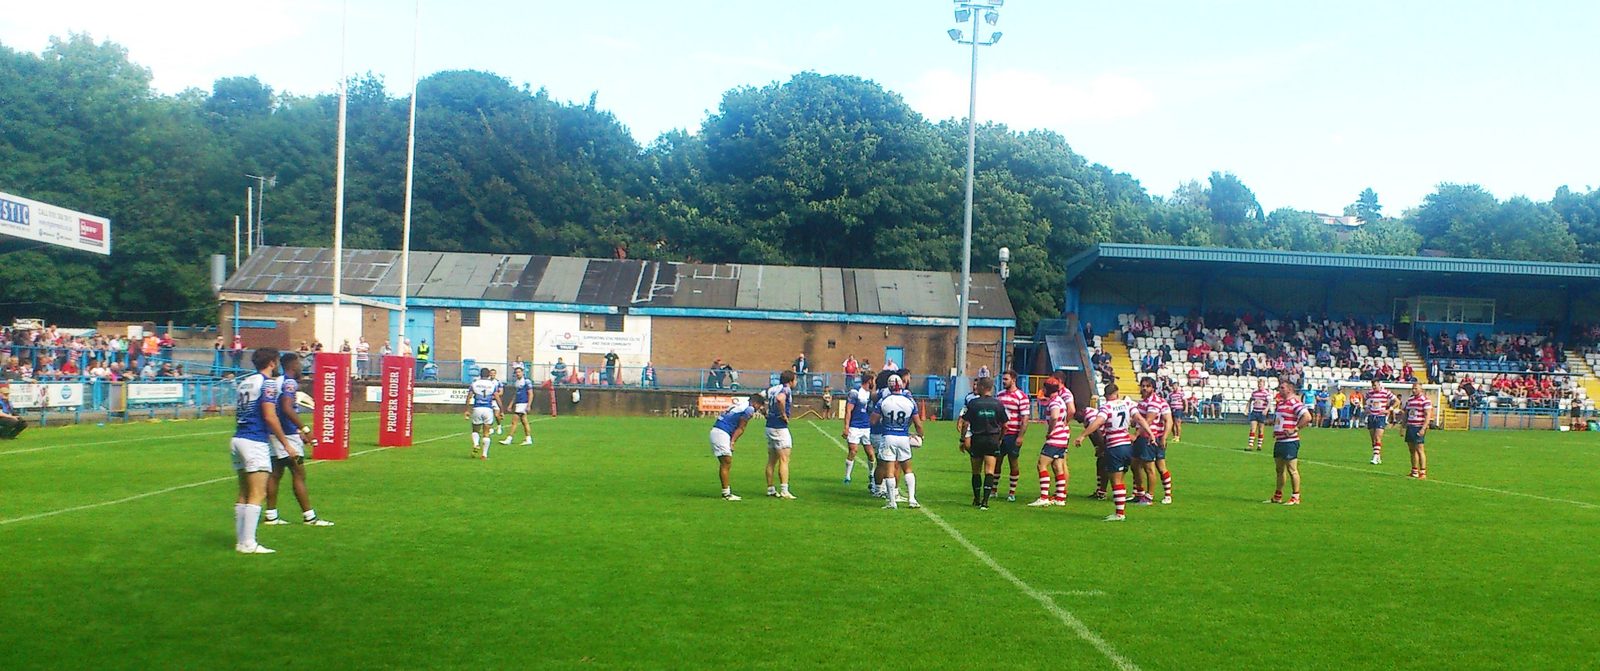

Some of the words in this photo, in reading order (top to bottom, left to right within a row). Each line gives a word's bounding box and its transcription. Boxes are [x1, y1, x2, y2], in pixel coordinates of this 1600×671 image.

[324, 372, 336, 402] CIDER
[389, 372, 400, 397] CIDER
[322, 404, 335, 444] PROPER
[387, 399, 398, 432] PROPER
[887, 410, 906, 426] 18
[1117, 411, 1126, 428] 7
